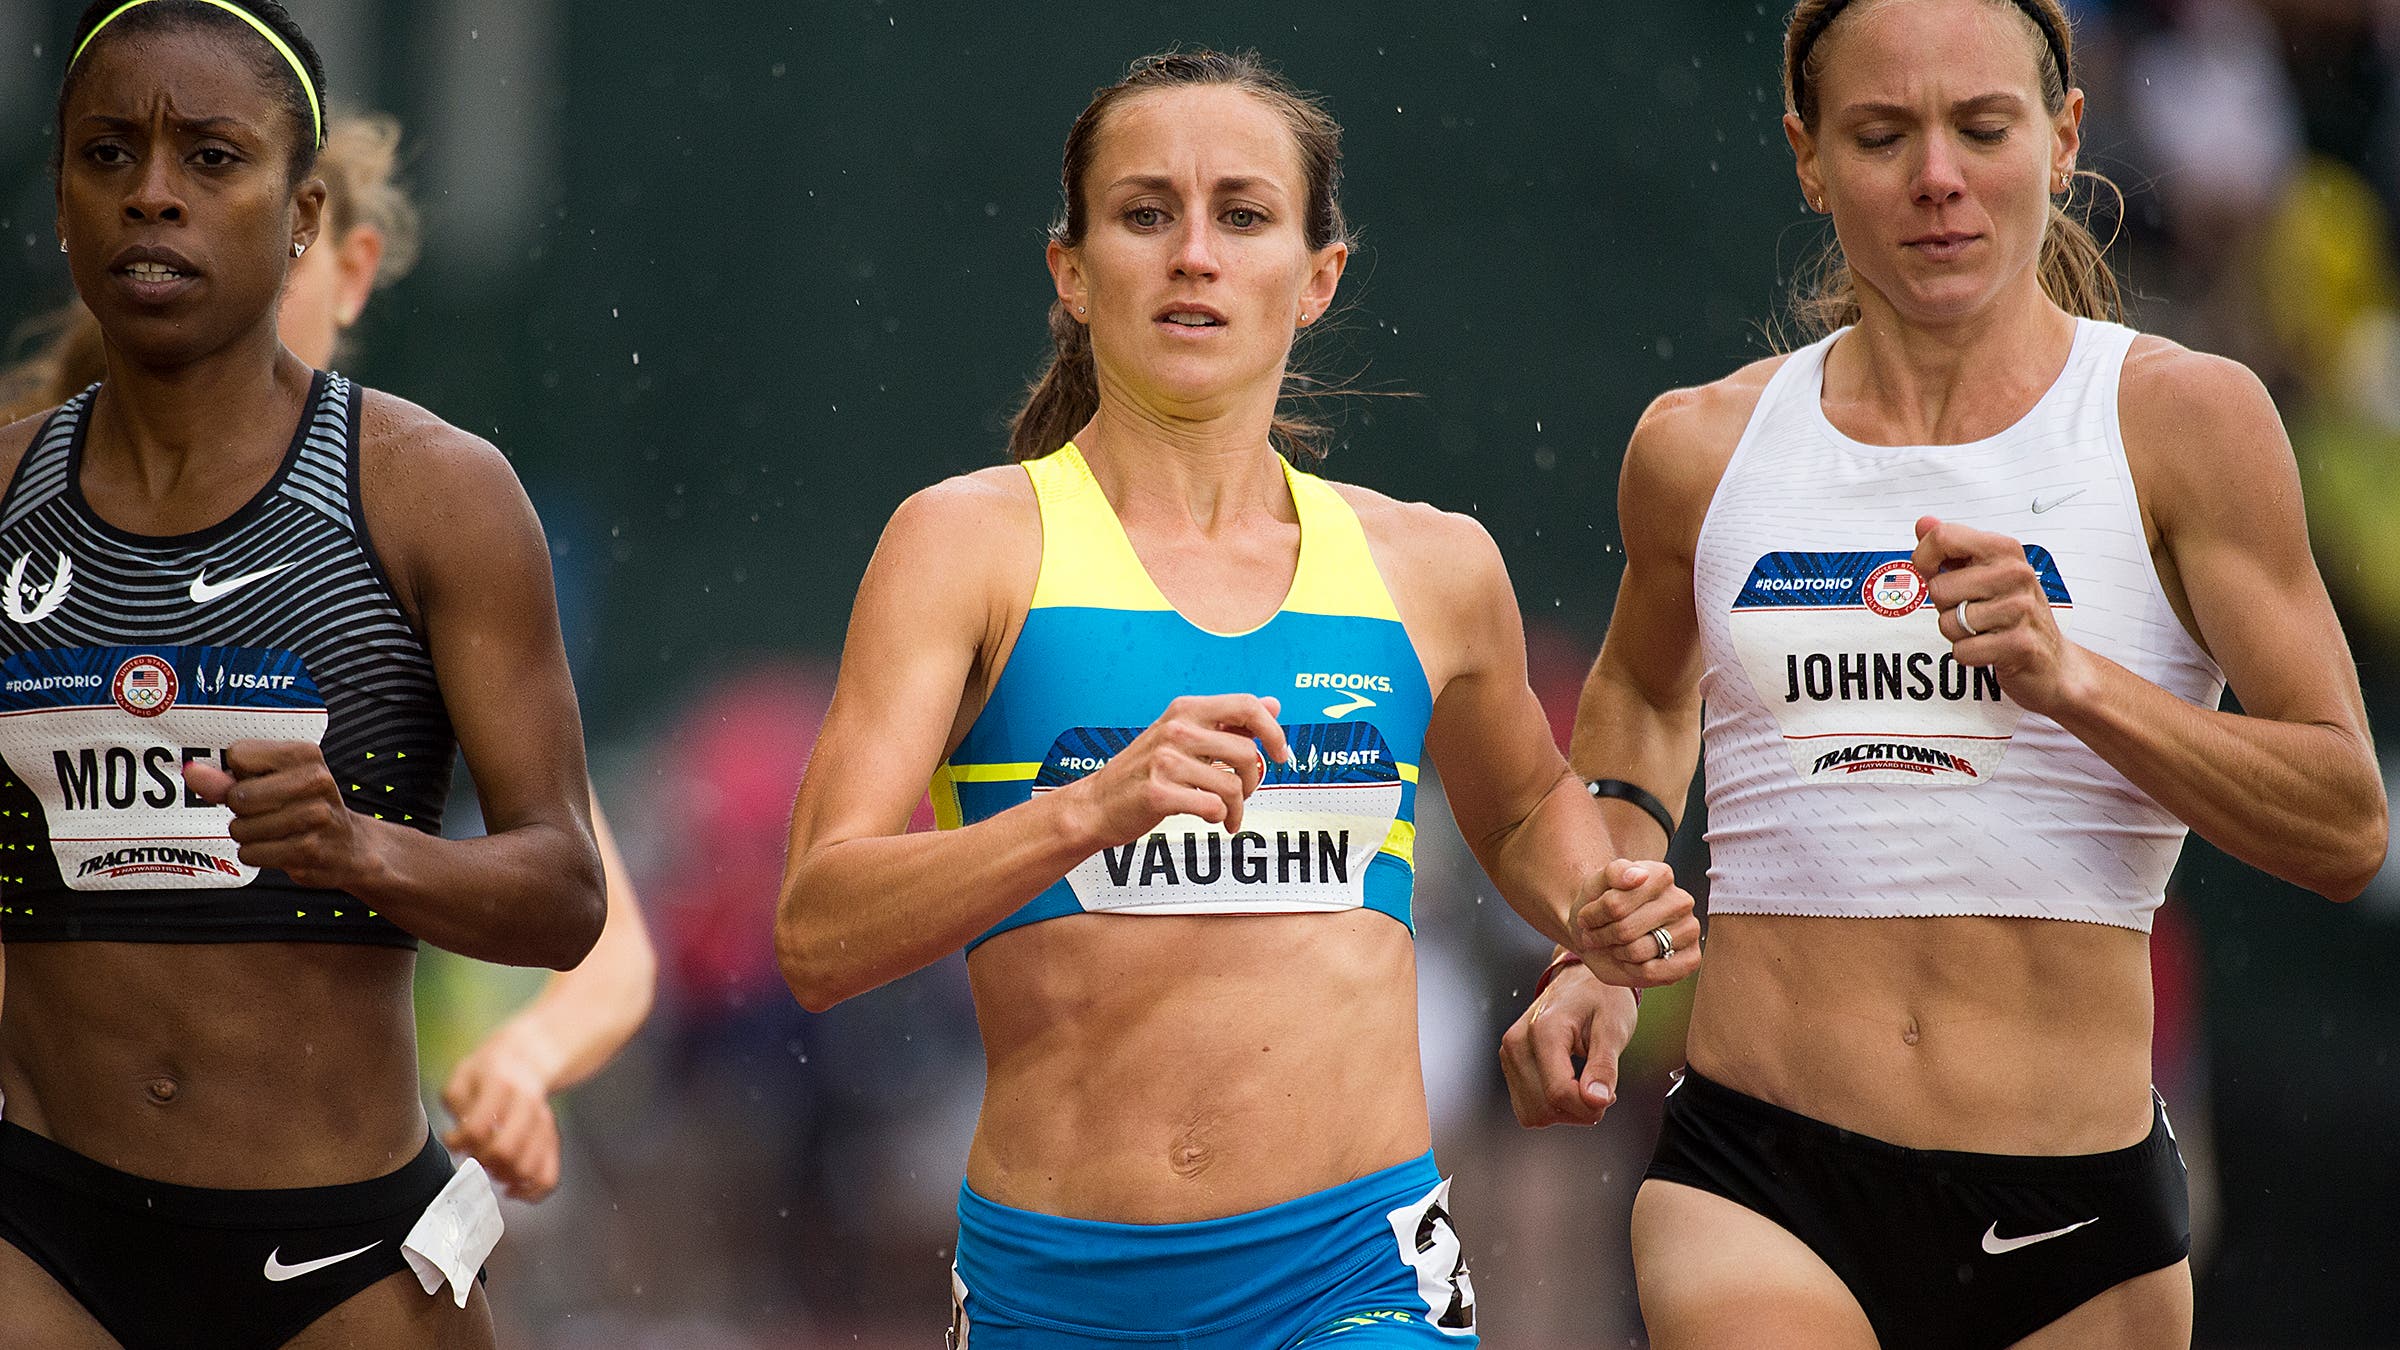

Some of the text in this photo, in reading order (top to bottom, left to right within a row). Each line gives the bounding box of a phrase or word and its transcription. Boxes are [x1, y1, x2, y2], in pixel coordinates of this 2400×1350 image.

[1872, 563, 1898, 580] UNITED
[1755, 577, 1854, 591] #ROADTORIO
[1866, 594, 1924, 617] OLYMPIC TEAM
[120, 658, 145, 677] UNITED
[6, 675, 103, 693] #ROADTORIO
[229, 673, 295, 690] USATF
[1784, 652, 2002, 703] JOHNSON
[155, 694, 174, 712] TEAM
[1322, 750, 1380, 766] USATF
[1859, 762, 1922, 772] HAYWARD FIELD
[53, 746, 233, 811] MOSE
[1100, 830, 1350, 887] VAUGHN
[121, 865, 183, 874] HAYWARD FIELD
